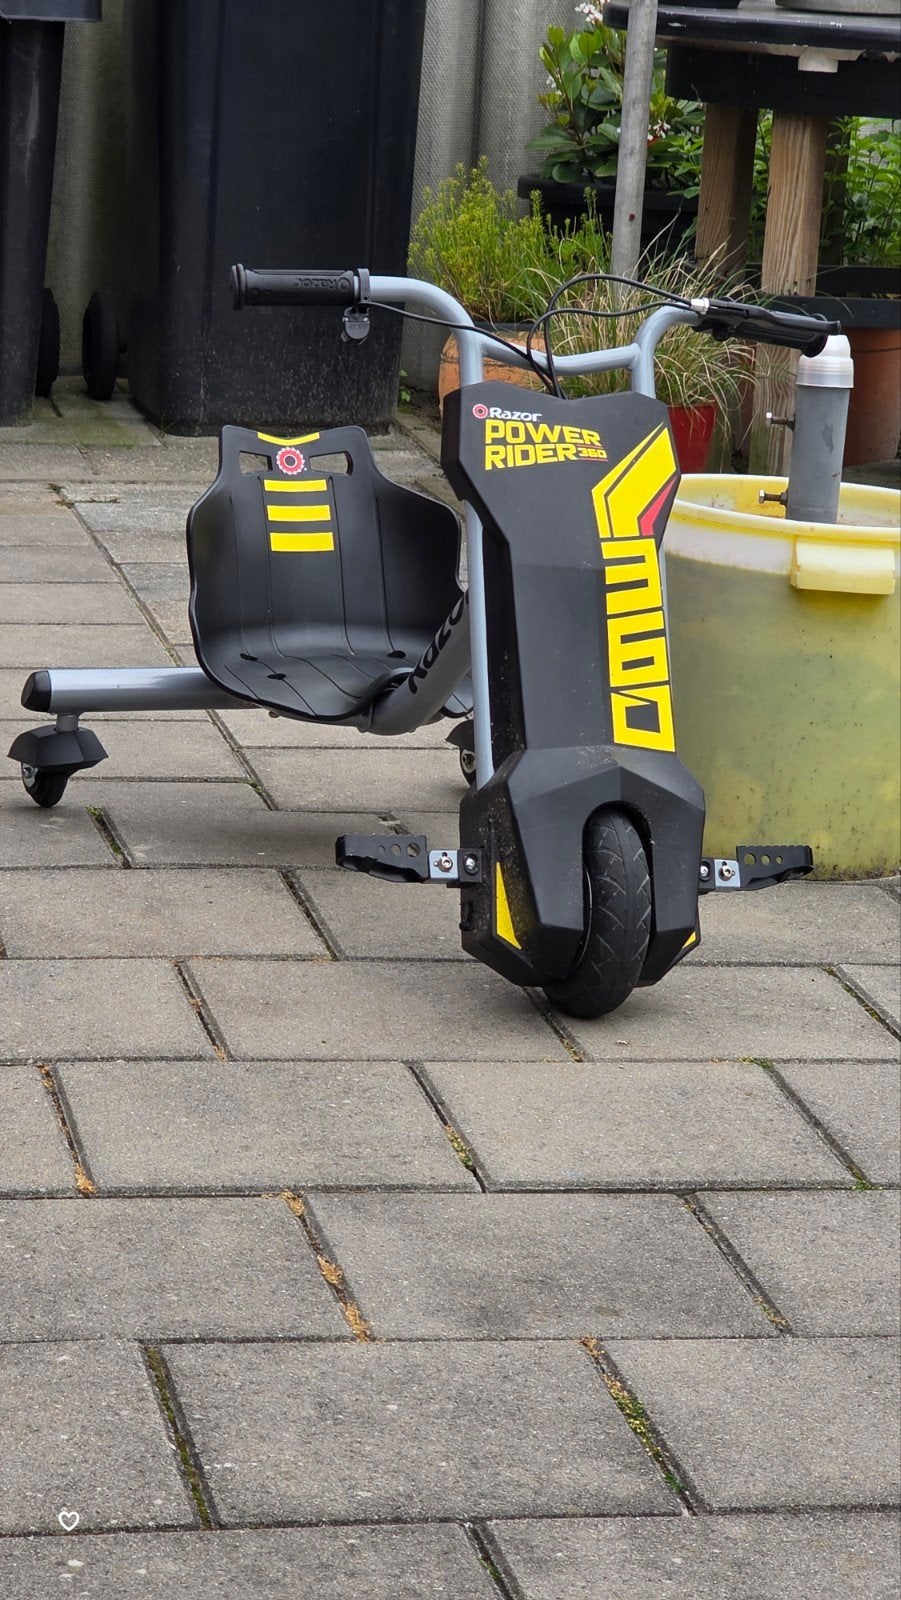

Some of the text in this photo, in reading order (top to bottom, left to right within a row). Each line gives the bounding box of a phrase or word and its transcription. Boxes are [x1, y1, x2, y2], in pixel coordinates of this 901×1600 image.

[489, 407, 542, 422] Razor
[485, 419, 601, 445] POWER
[485, 444, 608, 470] RIDER 360
